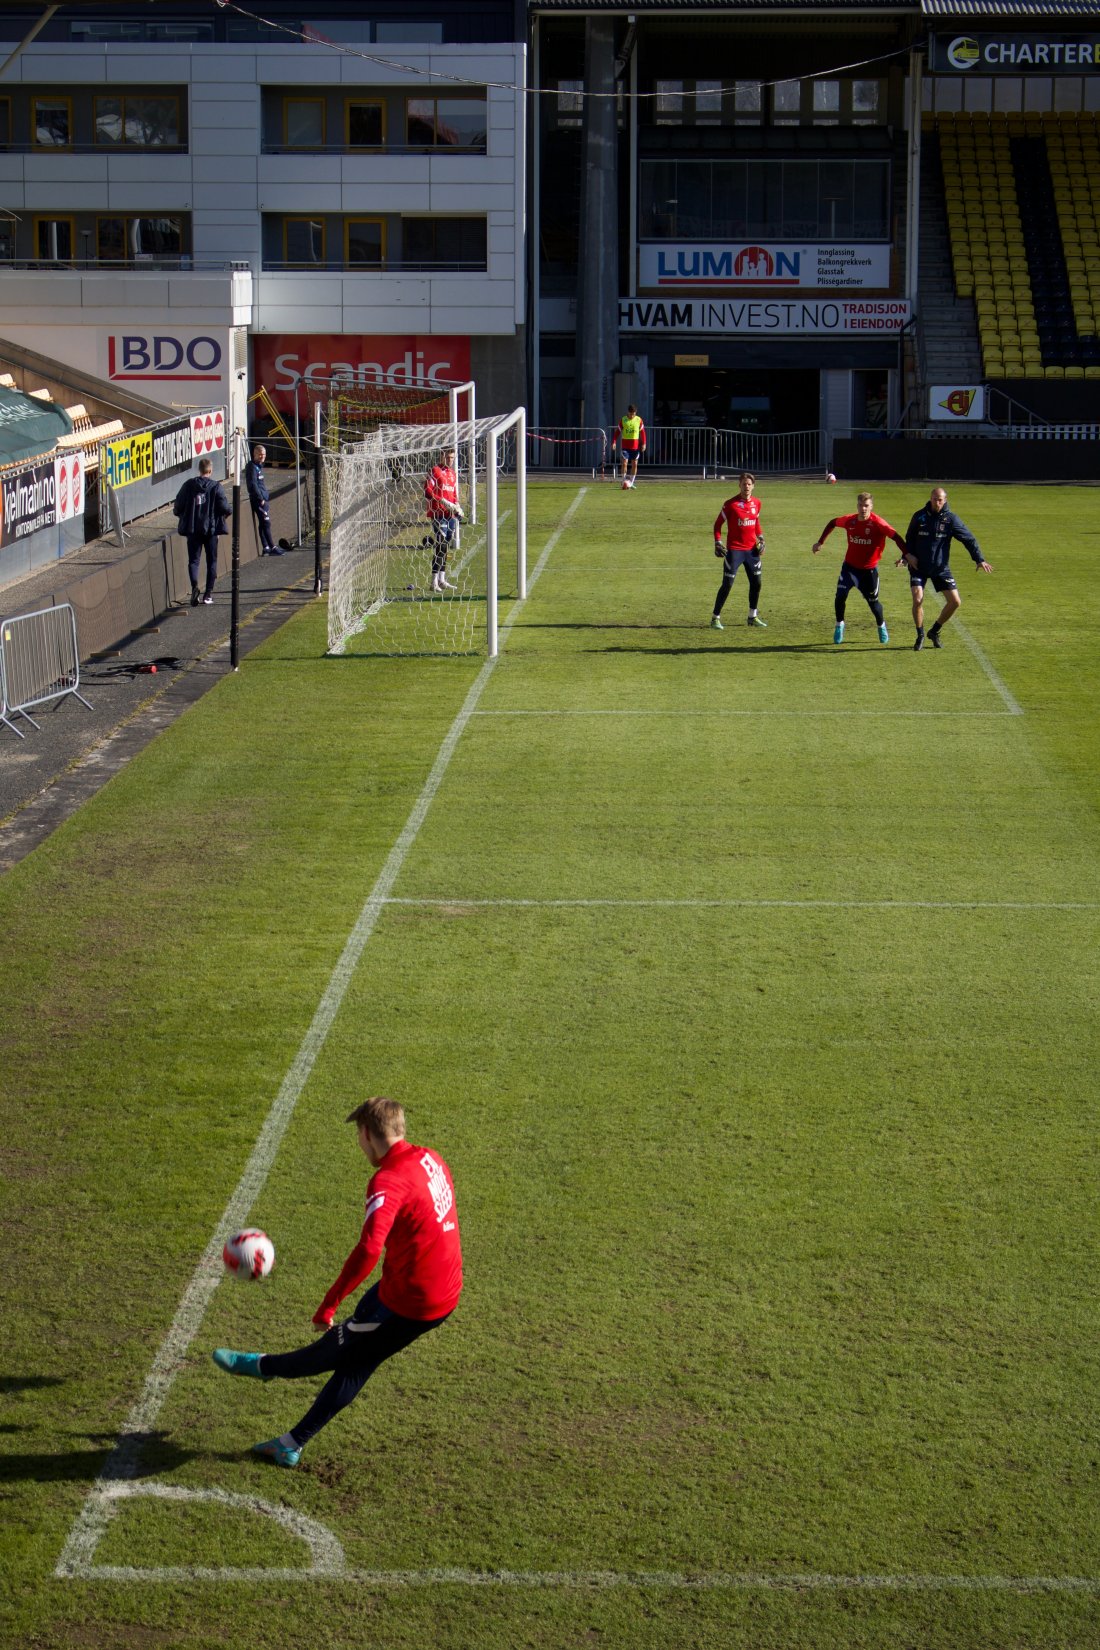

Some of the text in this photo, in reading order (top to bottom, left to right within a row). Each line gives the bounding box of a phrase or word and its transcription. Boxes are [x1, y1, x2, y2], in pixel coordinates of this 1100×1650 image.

[817, 249, 855, 257] Innglassing
[817, 258, 872, 267] Balkongrekkverk
[817, 277, 863, 286] Plisségardiner
[842, 303, 908, 314] TRADISJON
[701, 303, 840, 328] INVEST.NO
[850, 318, 905, 329] EIENDOM
[122, 336, 222, 371] BDO
[274, 351, 451, 391] Scandic
